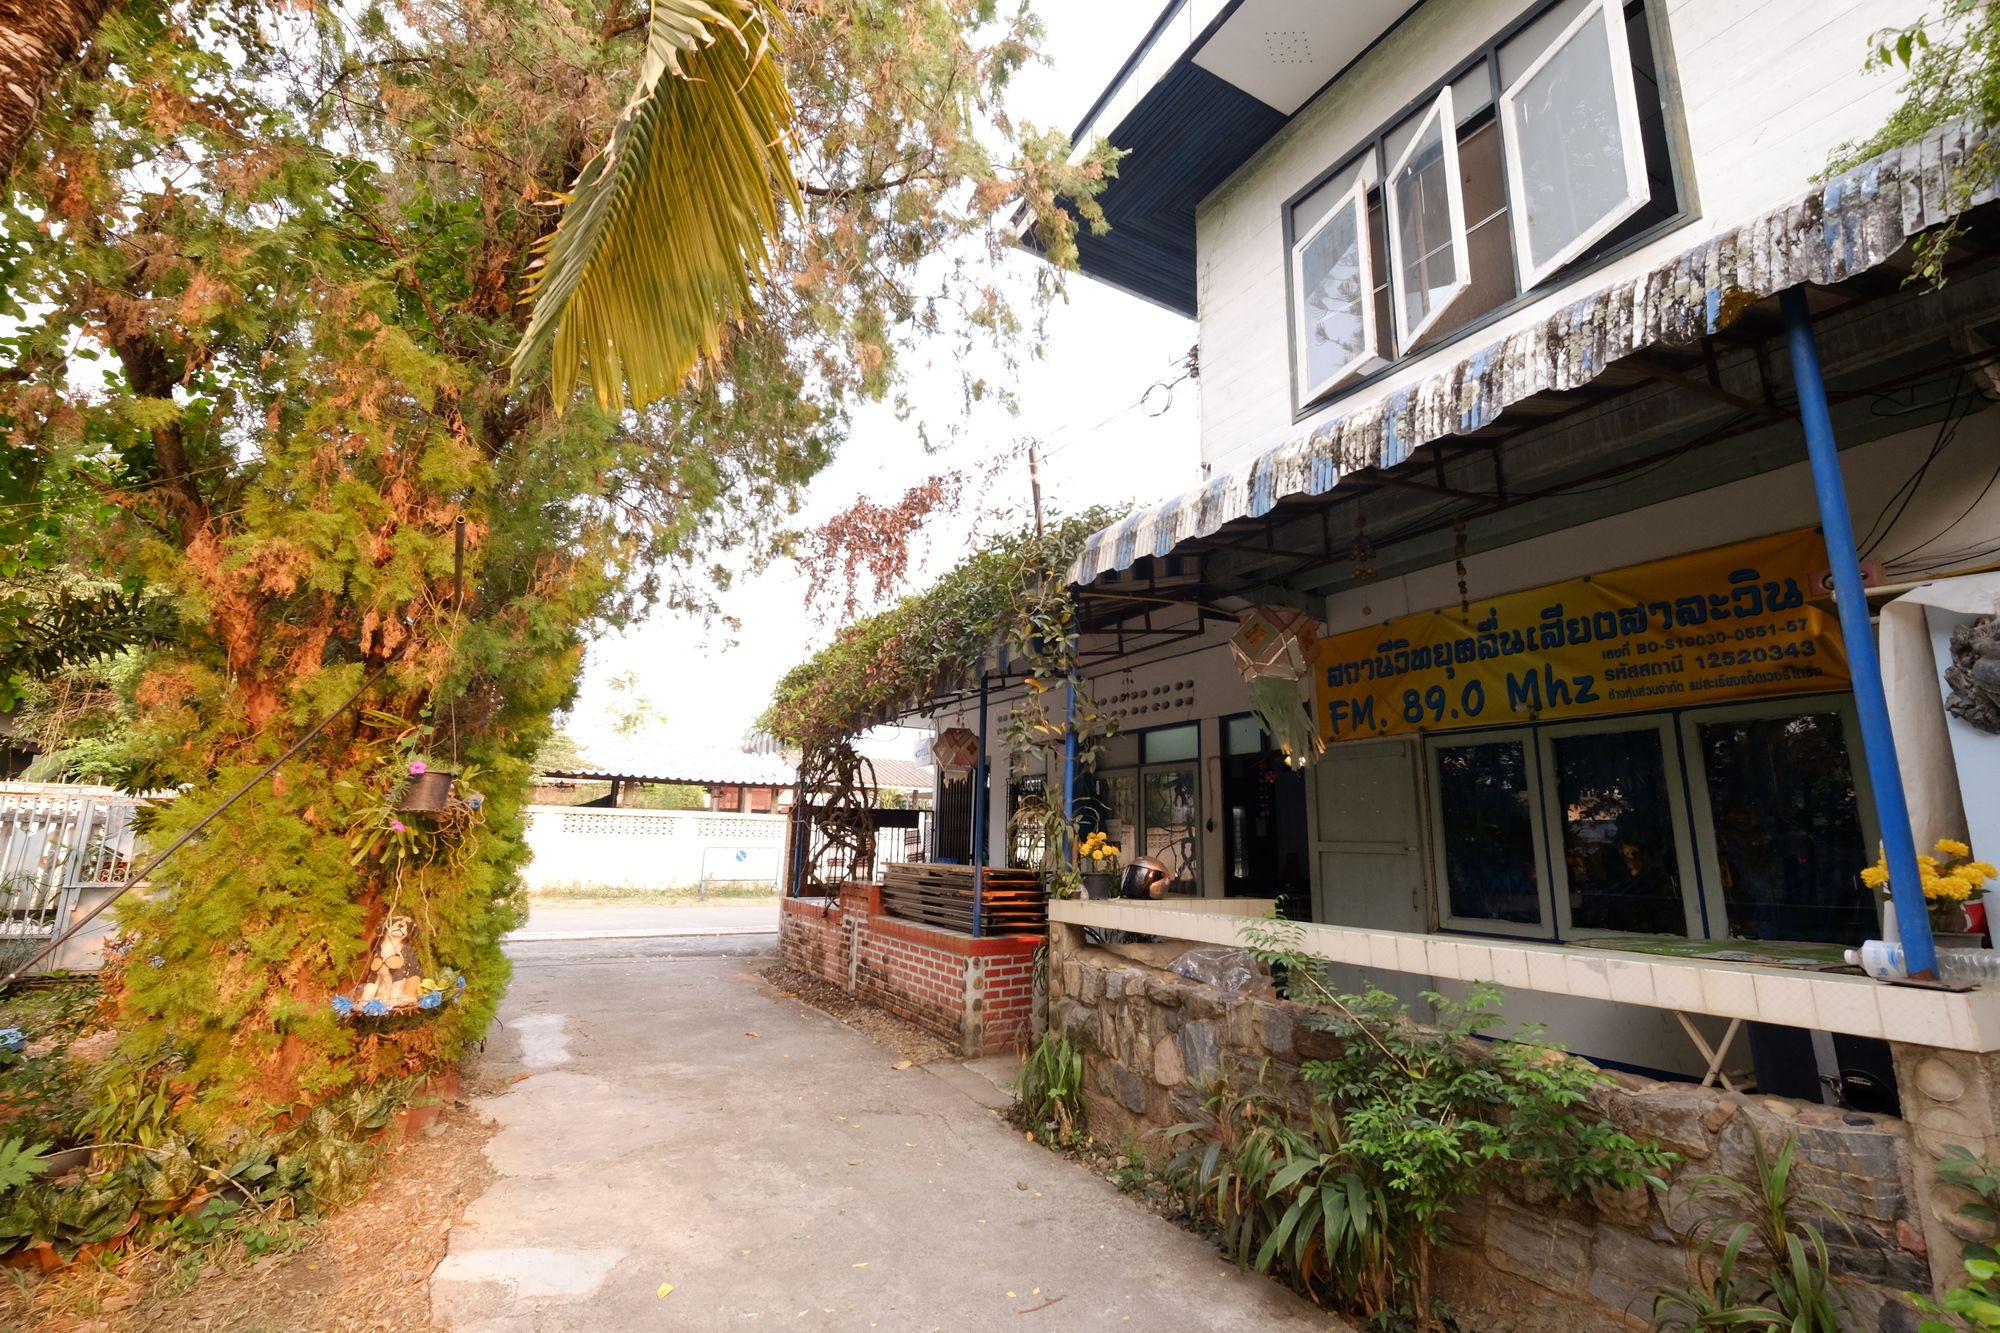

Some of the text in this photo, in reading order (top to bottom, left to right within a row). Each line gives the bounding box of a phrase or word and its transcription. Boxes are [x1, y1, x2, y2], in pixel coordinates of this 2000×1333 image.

[1327, 569, 1804, 688] สถานีวิทยุคลื่นเสียงสาละวิน
[1602, 641, 1631, 660] เลขที่
[1604, 639, 1817, 682] รหัสสถานี 12520343
[1328, 663, 1600, 734] FM. 89.0 Mhz
